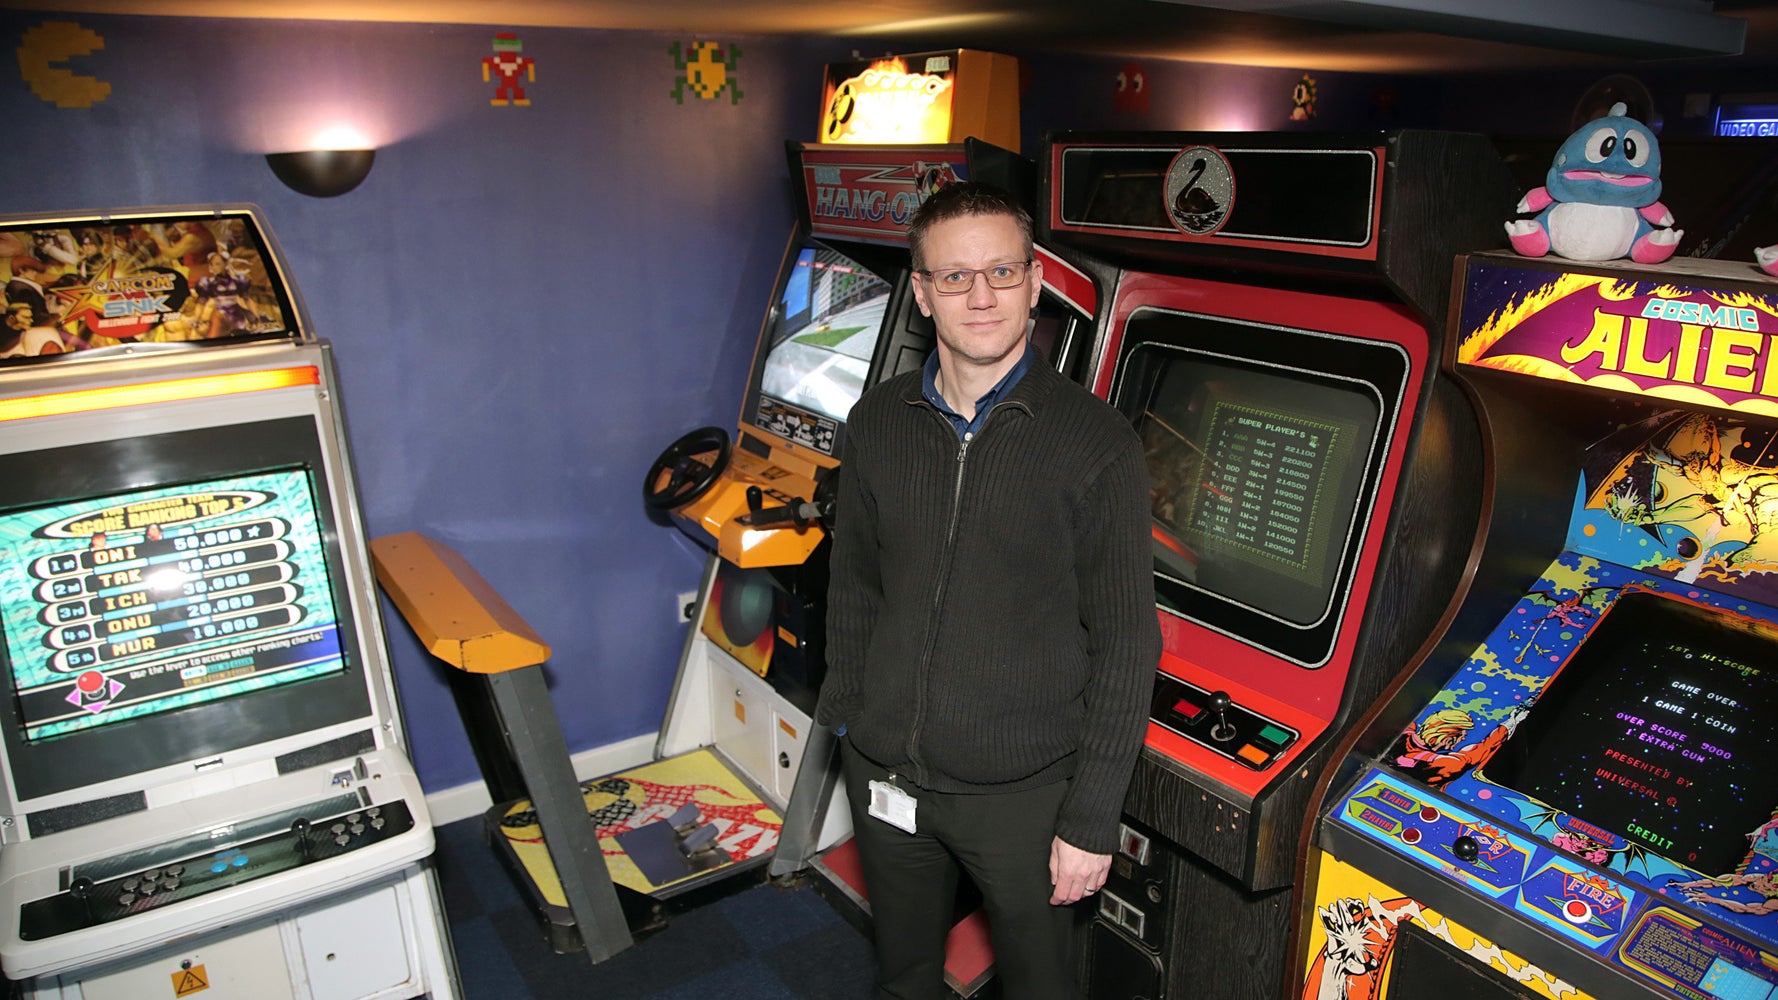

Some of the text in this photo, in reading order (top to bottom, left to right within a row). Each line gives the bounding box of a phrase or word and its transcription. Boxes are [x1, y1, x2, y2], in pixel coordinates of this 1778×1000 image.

[1720, 122, 1778, 137] VIDEO GA
[91, 274, 174, 295] CAPCOM
[104, 294, 172, 317] SNK
[1641, 297, 1760, 331] COSMIC
[1238, 417, 1306, 439] SUPER PLAYER'S
[1281, 456, 1313, 469] 220200
[1284, 445, 1316, 458] 221100
[1223, 474, 1238, 483] EEE
[1276, 478, 1307, 491] 214500
[126, 498, 184, 513] CHARACTER
[186, 495, 214, 504] TEAM
[70, 497, 245, 537] SCORE RANKING TOP 5
[94, 546, 137, 565] ONI
[98, 569, 143, 588] TAK
[105, 592, 148, 611] ICH
[107, 614, 152, 634] ONU
[112, 636, 156, 657] MUR
[130, 632, 324, 679] Use the lever to access other ranking charts!
[1668, 644, 1760, 676] 1ST HI-SCORE
[1671, 681, 1738, 708] GAME OVER
[1641, 695, 1737, 735] 1 GAME 1 COIN
[1616, 711, 1645, 727] OVER
[1650, 723, 1688, 742] SCORE
[1625, 728, 1633, 736] 1
[1638, 732, 1676, 752] EXTRA
[1605, 748, 1693, 789] PRESENTED BY
[1595, 767, 1659, 801] UNIVERSAL
[1383, 790, 1411, 809] 1 PLAYER
[1361, 809, 1372, 818] 2
[1568, 817, 1616, 845] UNIVERSAL
[1627, 822, 1697, 862] CREDIT 0
[1567, 878, 1615, 909] FIRE
[1702, 927, 1724, 940] COSMIC
[1720, 937, 1757, 958] ALIEN
